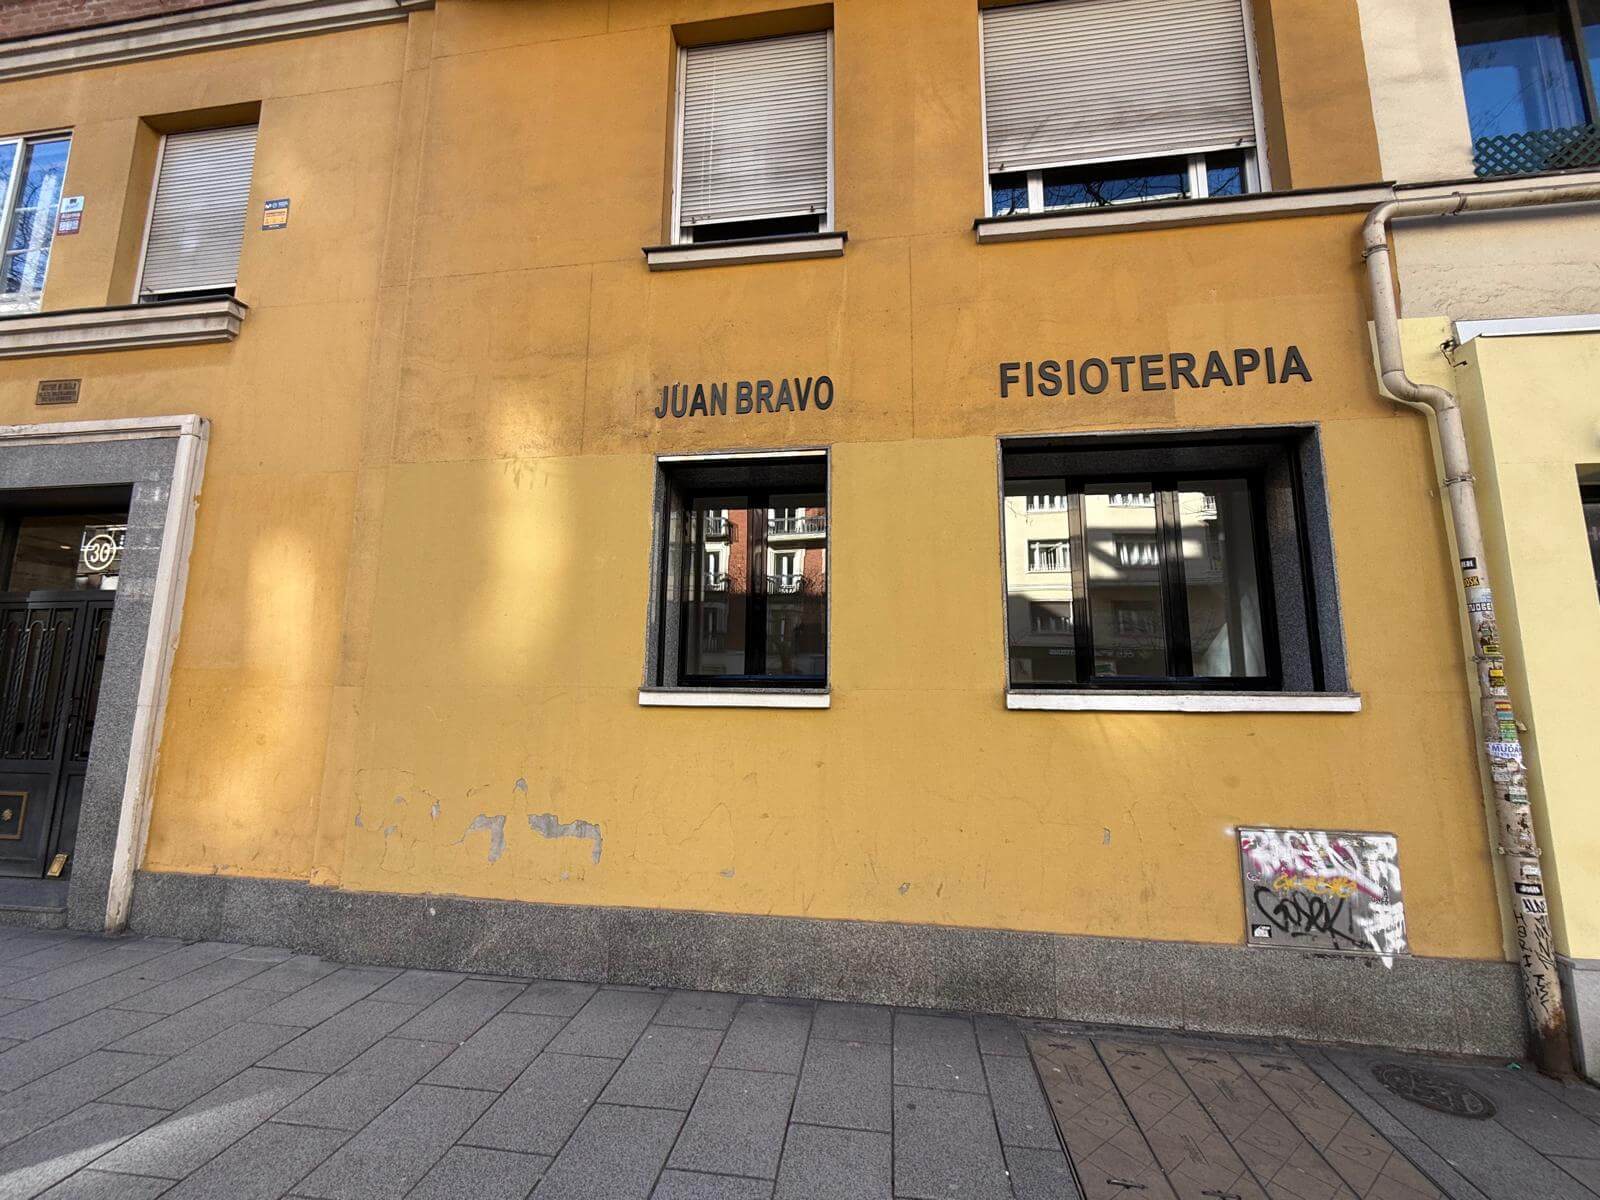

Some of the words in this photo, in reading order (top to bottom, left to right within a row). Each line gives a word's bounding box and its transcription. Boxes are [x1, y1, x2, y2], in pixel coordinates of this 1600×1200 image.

[1000, 346, 1312, 398] FISIOTERAPIA
[655, 383, 728, 418] JUAN
[735, 375, 834, 414] BRAVO
[90, 543, 110, 562] 30
